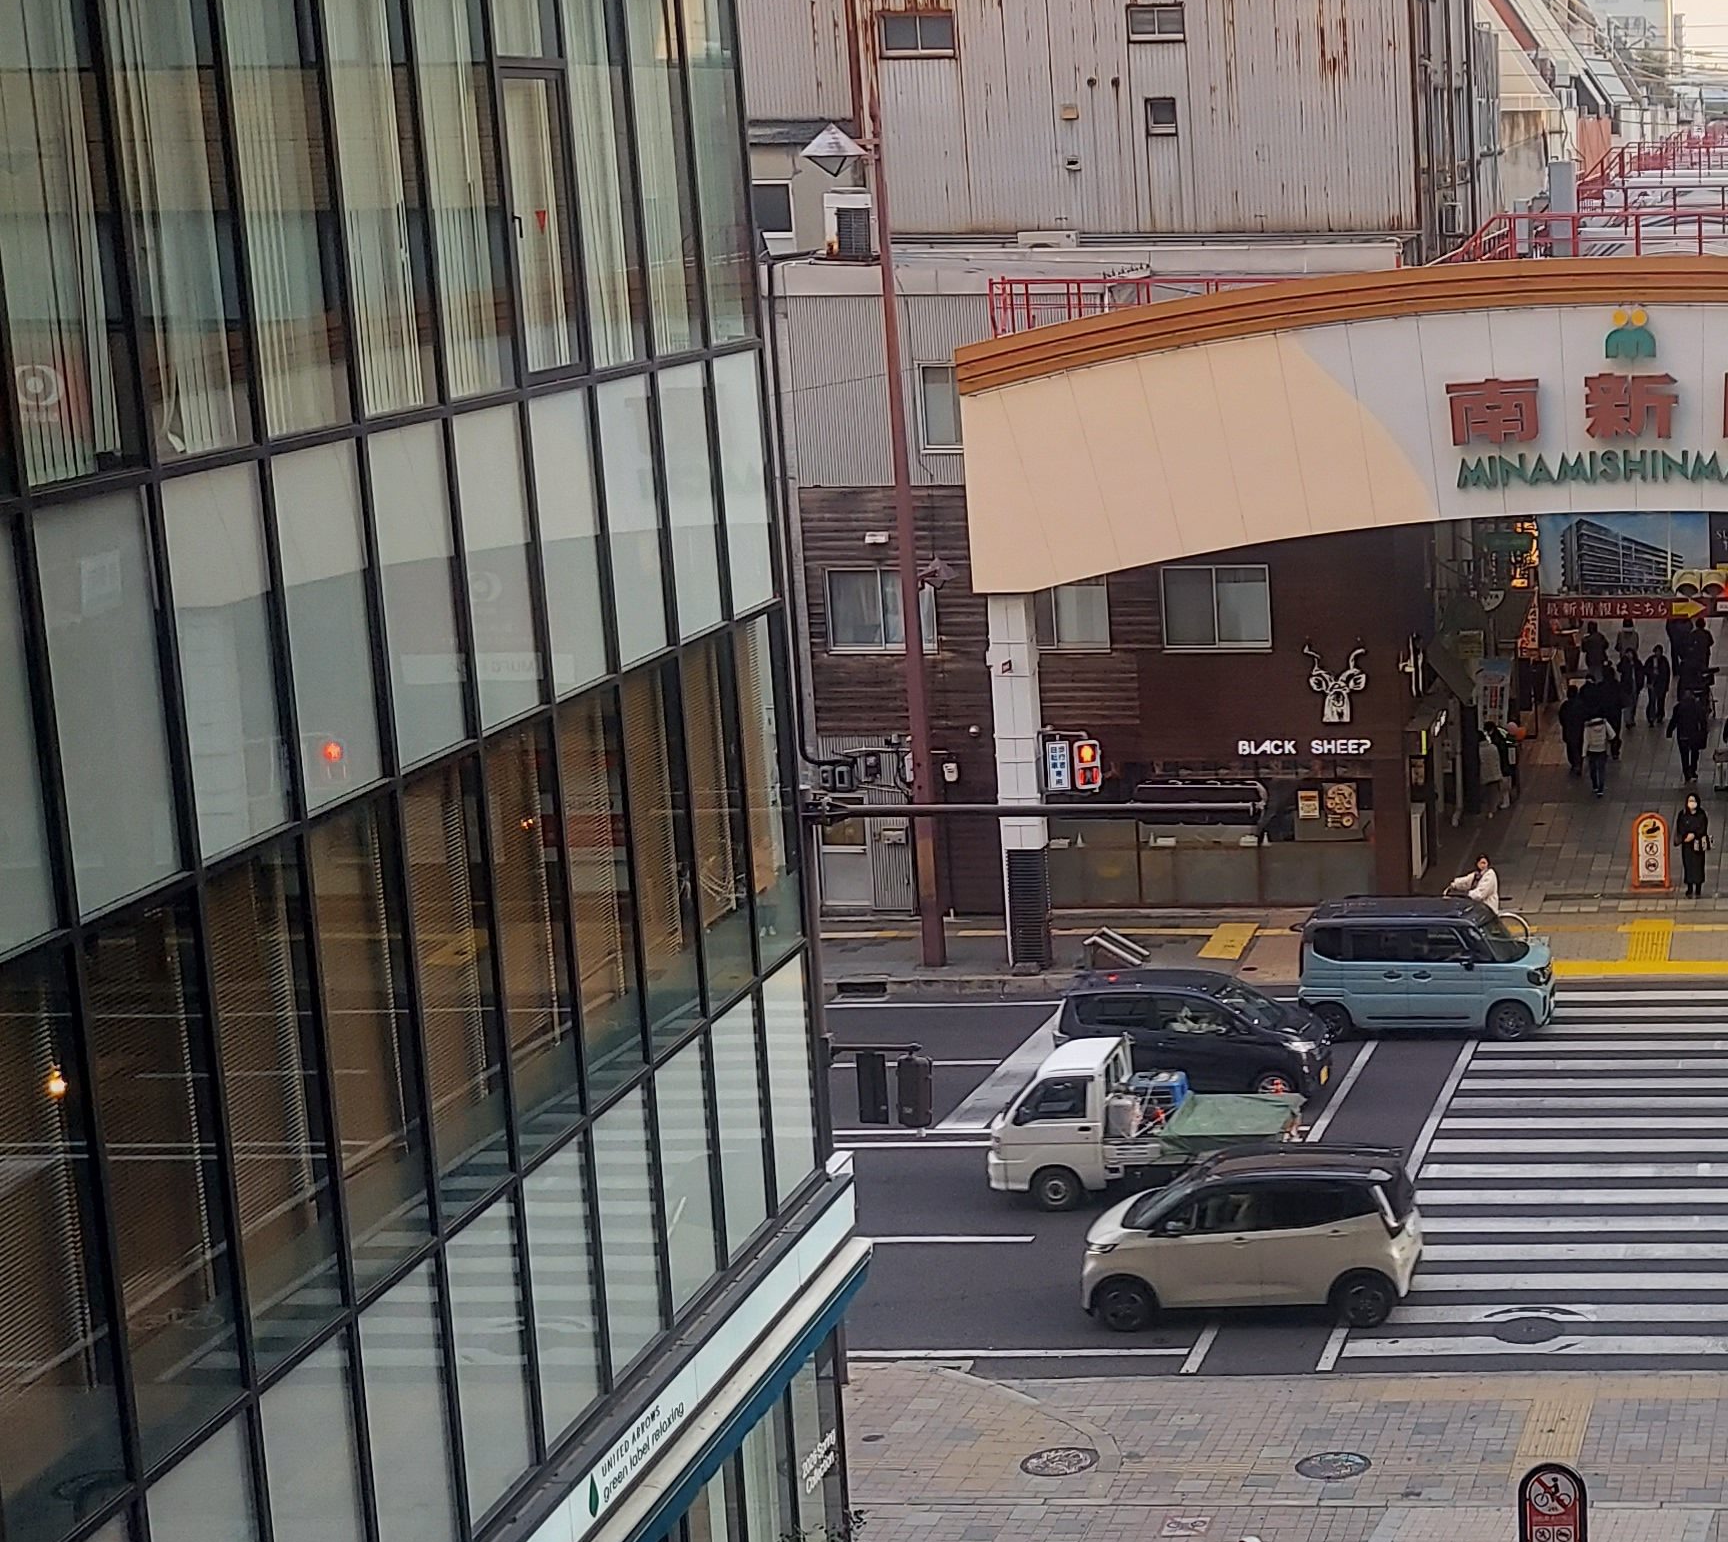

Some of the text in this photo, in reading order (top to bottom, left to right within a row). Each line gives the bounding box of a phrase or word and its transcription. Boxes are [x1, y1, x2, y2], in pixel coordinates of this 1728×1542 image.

[1238, 740, 1297, 755] BLACK
[601, 1399, 660, 1477] UNITED ARROWS
[603, 1401, 684, 1503] green label relaxing
